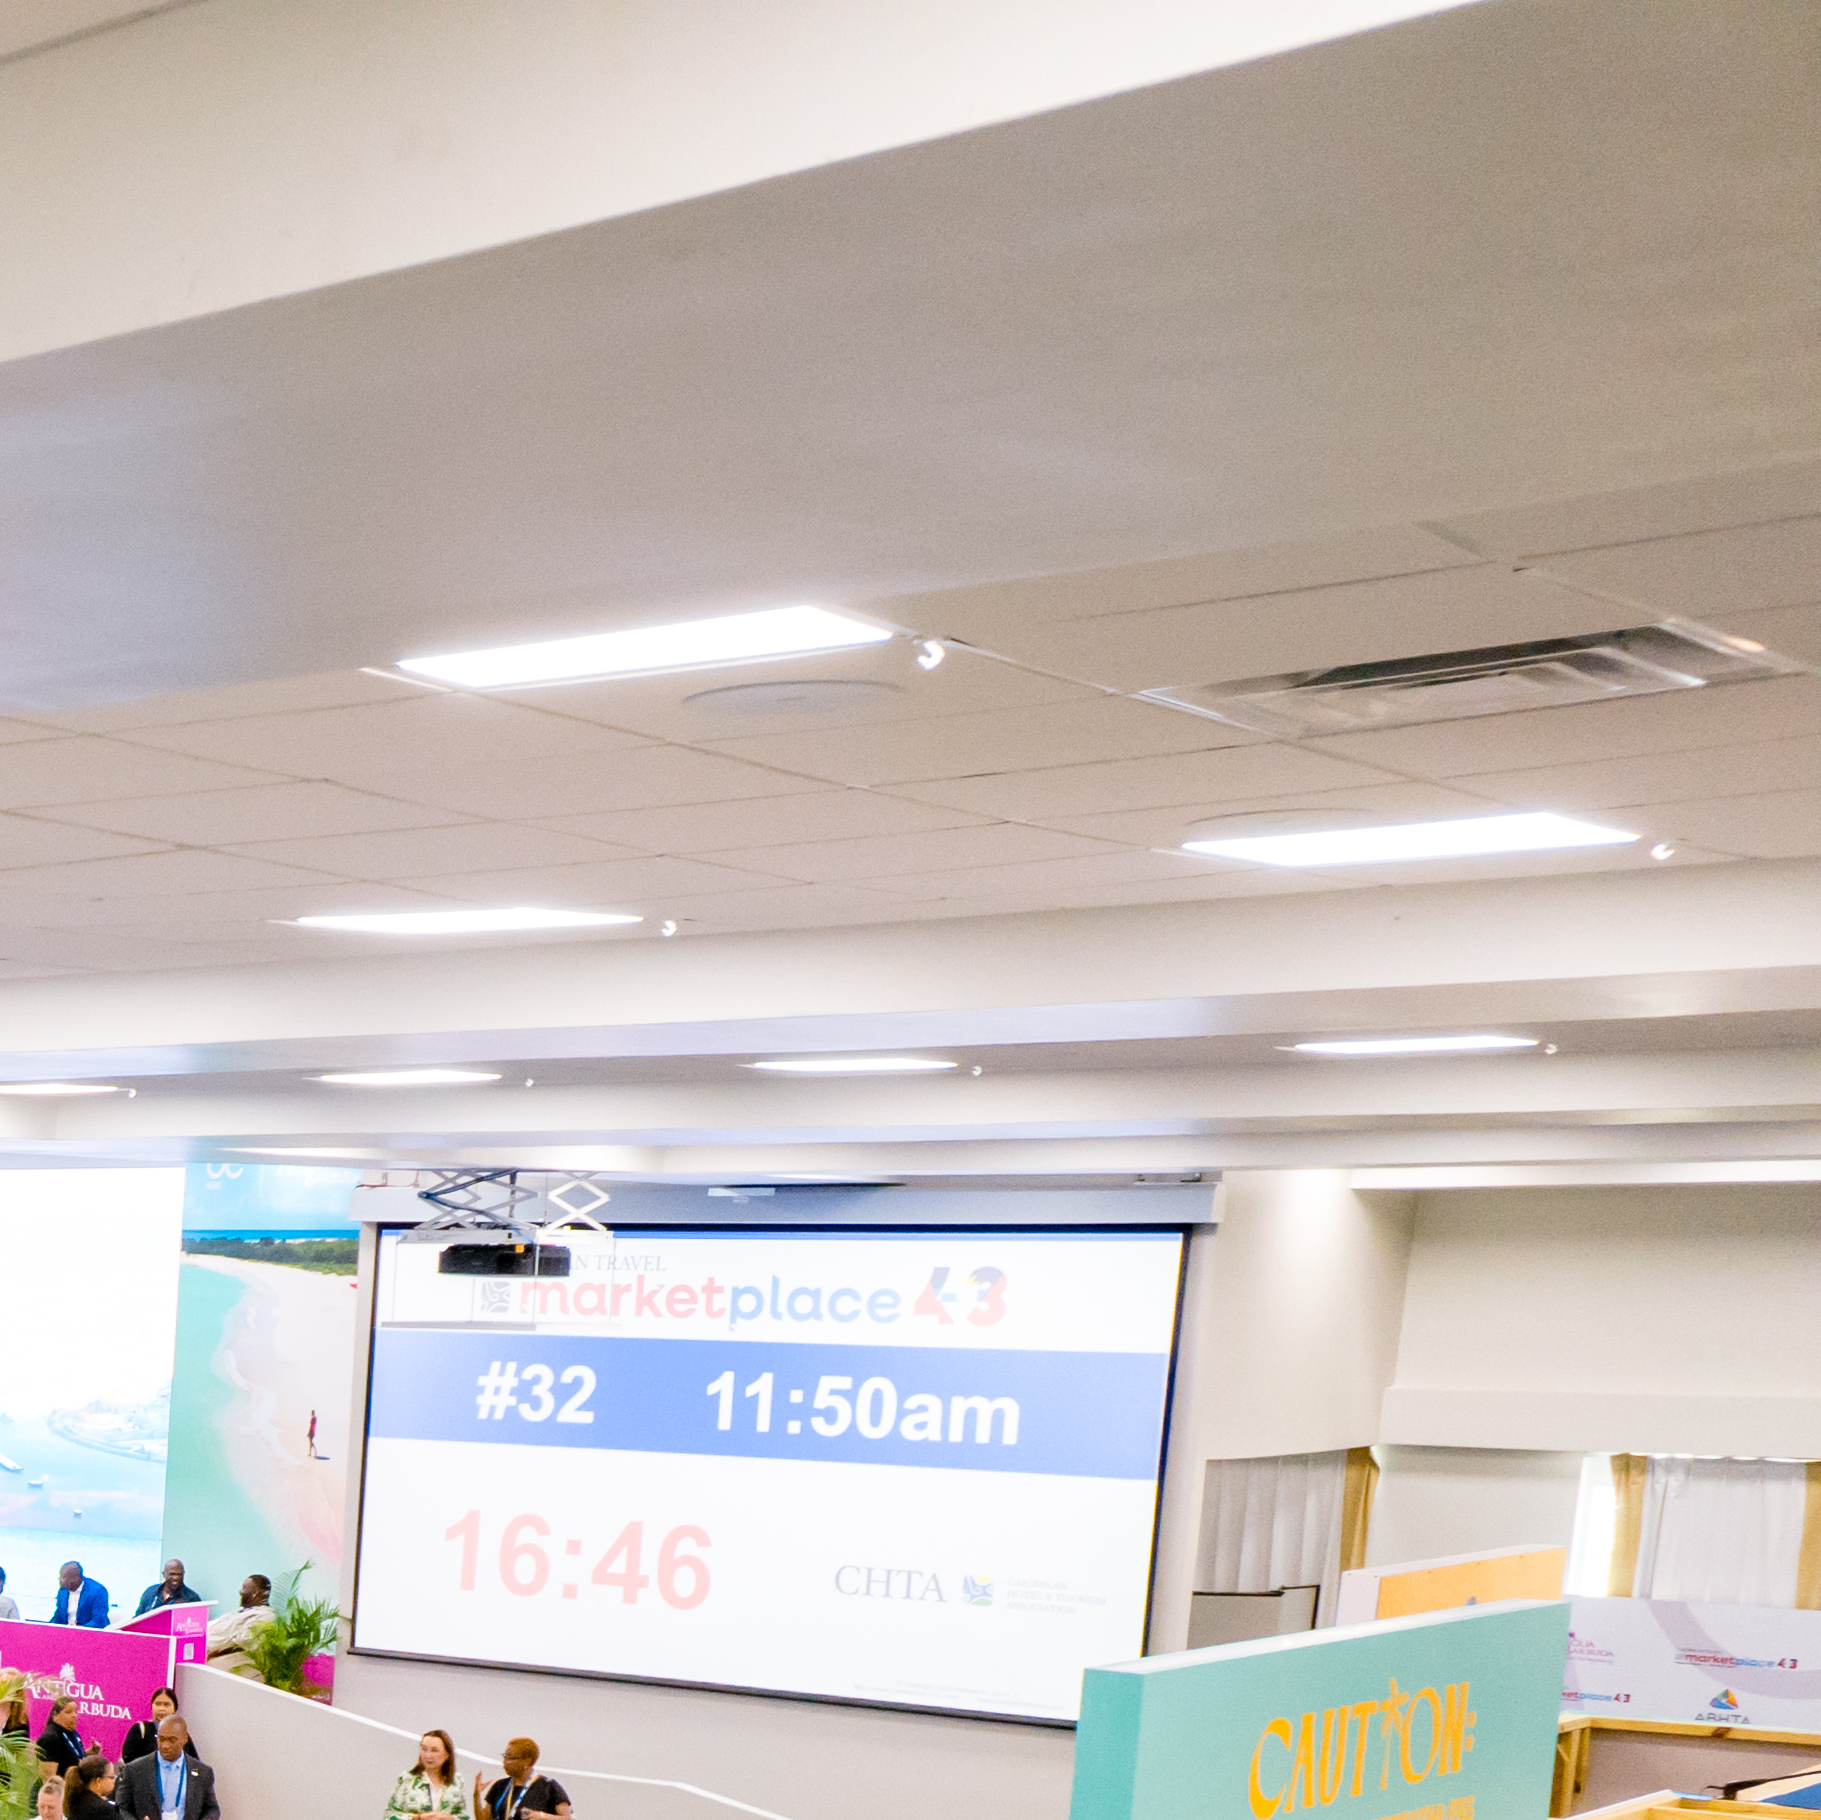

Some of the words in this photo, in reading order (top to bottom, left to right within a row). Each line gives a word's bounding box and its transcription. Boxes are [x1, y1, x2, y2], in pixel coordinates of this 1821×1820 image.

[593, 1254, 667, 1273] TRAVEL
[519, 1273, 902, 1331] marketplace
[913, 1265, 1009, 1328] 43
[476, 1360, 597, 1424] #32
[705, 1371, 1021, 1446] 11:50am
[443, 1508, 714, 1611] 16:46
[834, 1564, 948, 1604] CHTA
[77, 1701, 132, 1721] RBUDA
